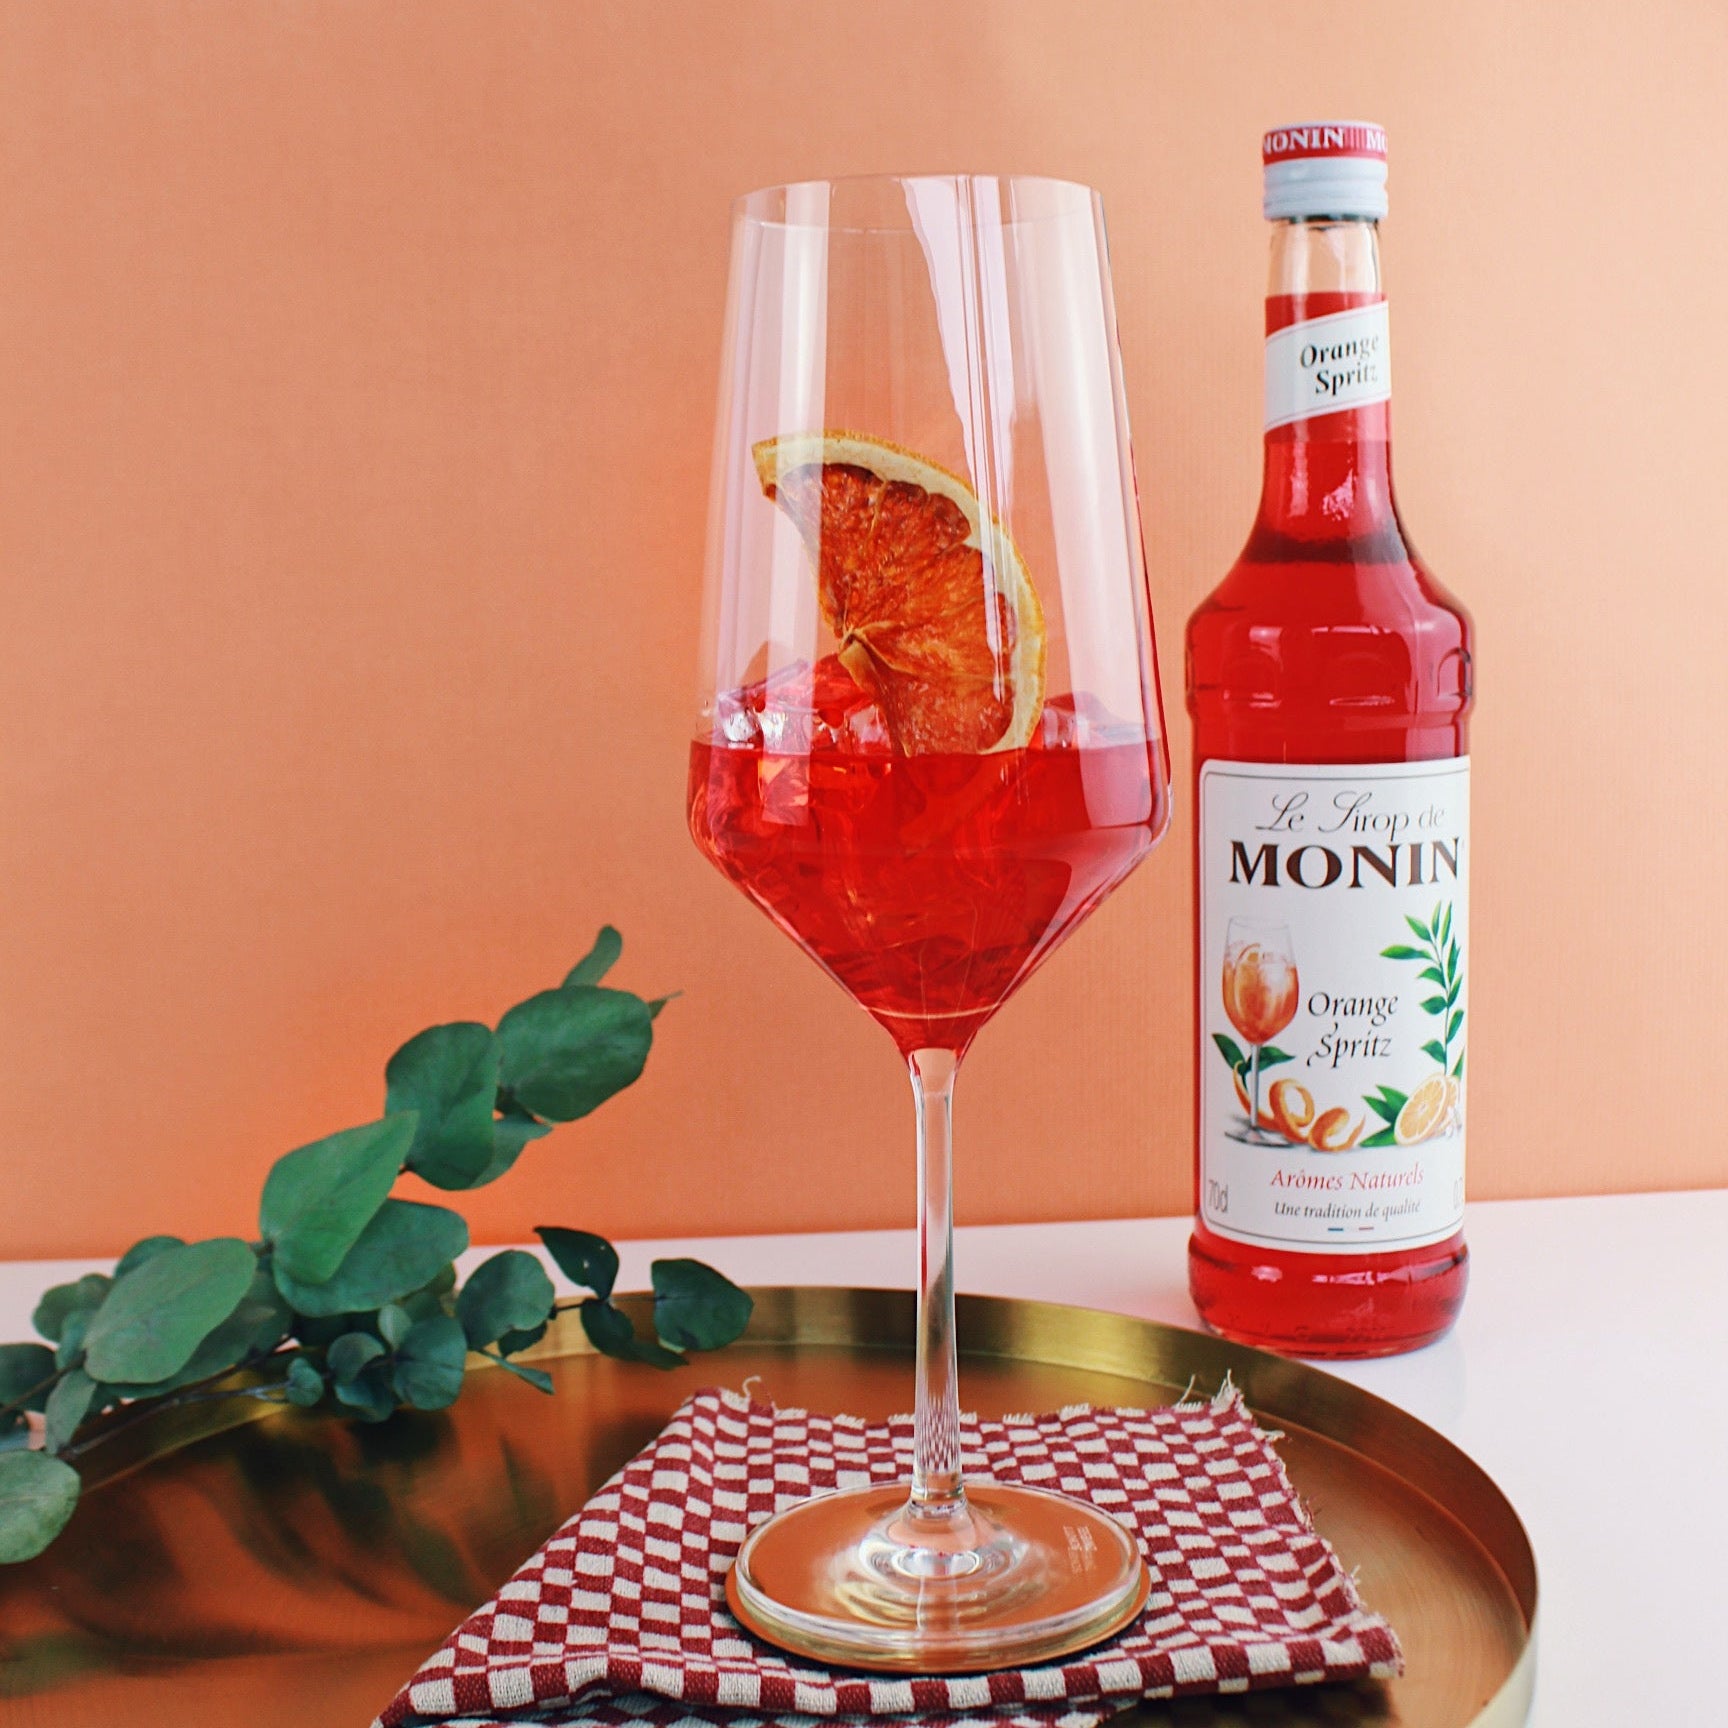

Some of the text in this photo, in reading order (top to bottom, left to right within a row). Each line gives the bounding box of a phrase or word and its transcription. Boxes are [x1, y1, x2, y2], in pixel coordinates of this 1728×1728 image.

[1300, 334, 1379, 369] Orange
[1315, 362, 1378, 396] Spritz
[1255, 791, 1445, 843] Le Sirop de
[1229, 837, 1459, 889] MONIN
[1307, 991, 1398, 1027] Orange
[1306, 1022, 1393, 1069] Spritz
[1270, 1162, 1424, 1191] Arômes Naturels
[1274, 1198, 1421, 1222] Une tradition de qualité
